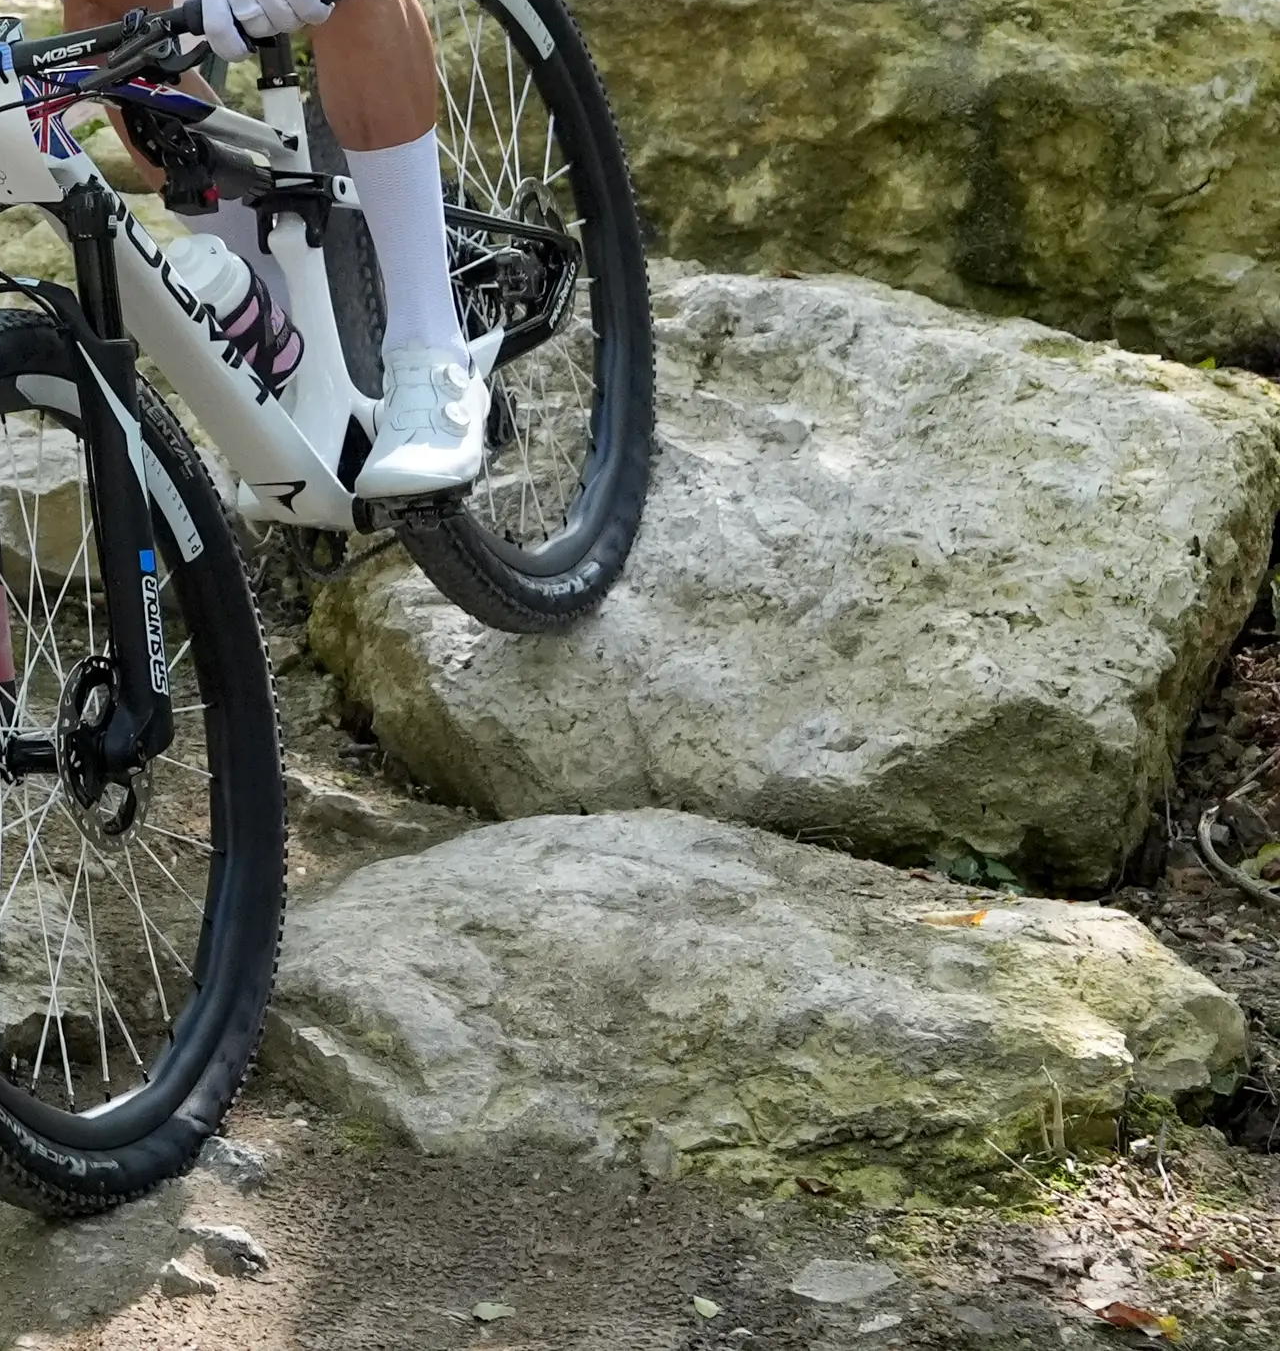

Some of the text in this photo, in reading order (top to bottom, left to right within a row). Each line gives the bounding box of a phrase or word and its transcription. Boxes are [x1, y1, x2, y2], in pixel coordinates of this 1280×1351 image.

[187, 531, 201, 554] P1
[142, 576, 168, 695] SR SUNTOUR
